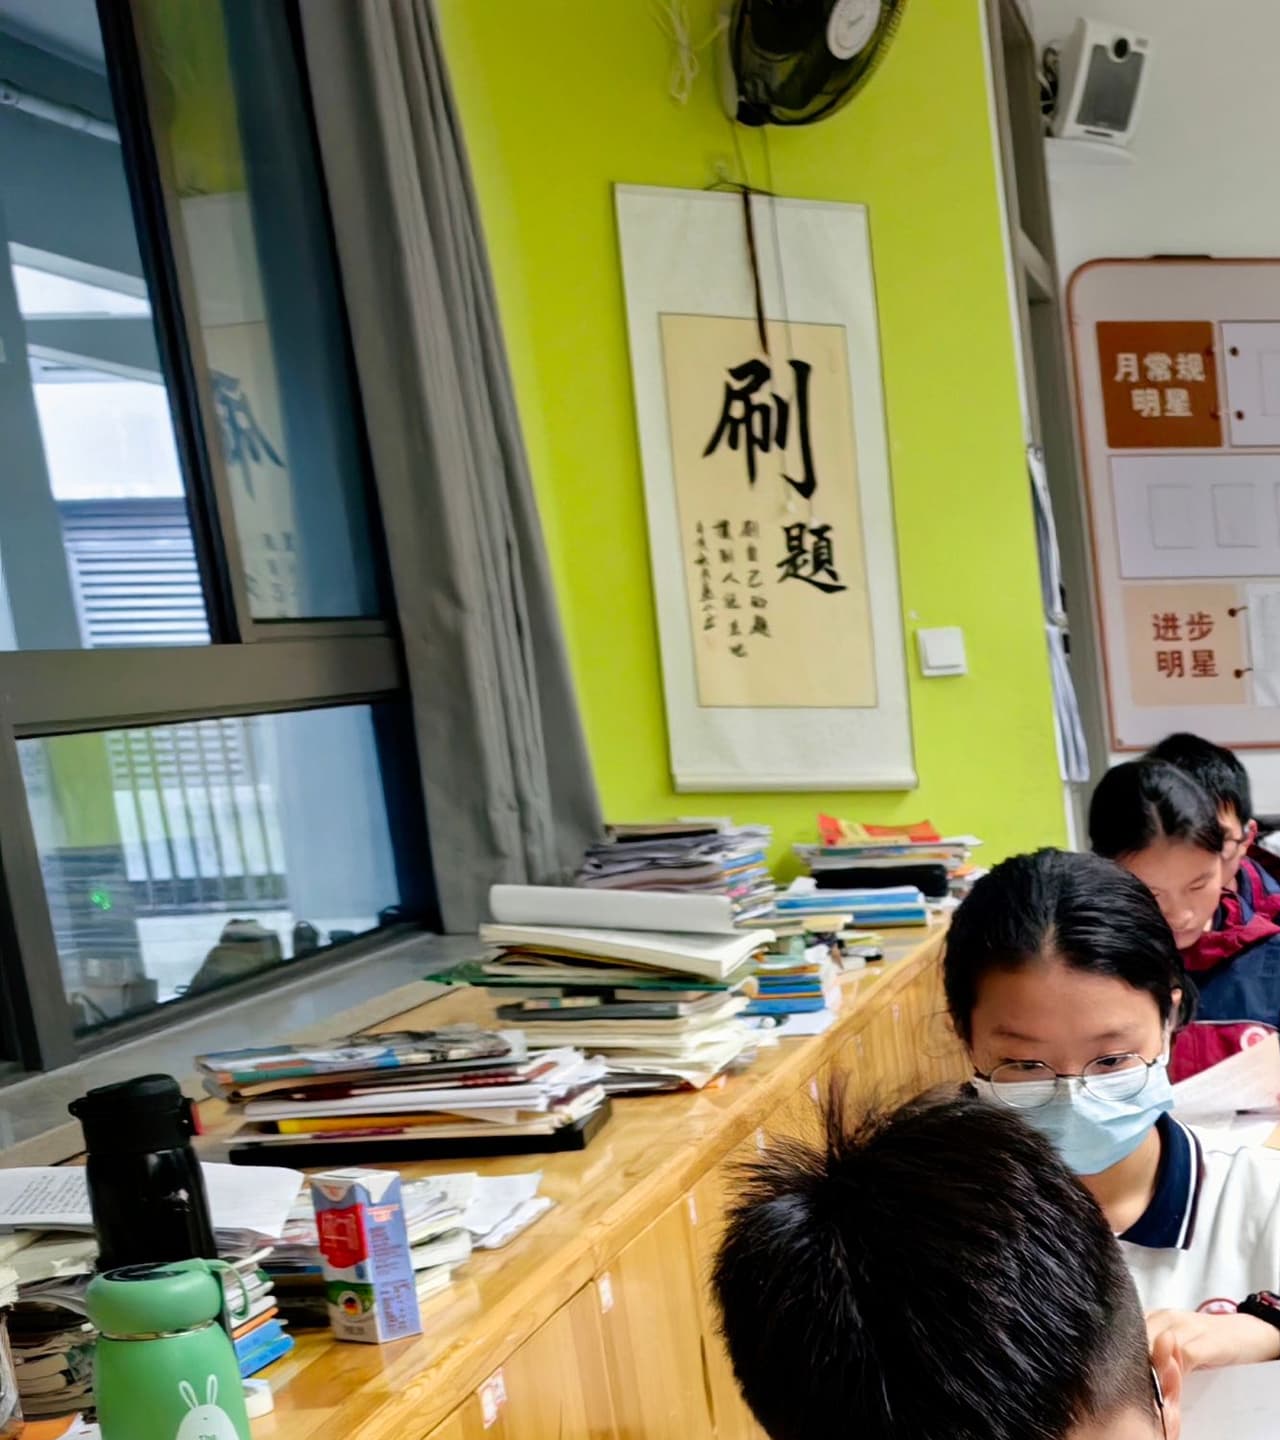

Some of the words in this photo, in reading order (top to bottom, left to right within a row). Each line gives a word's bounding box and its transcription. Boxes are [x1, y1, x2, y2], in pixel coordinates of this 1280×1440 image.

[1114, 353, 1206, 383] 月常规
[1131, 387, 1193, 418] 明星
[1152, 612, 1215, 641] 进步
[1156, 650, 1219, 680] 明星
